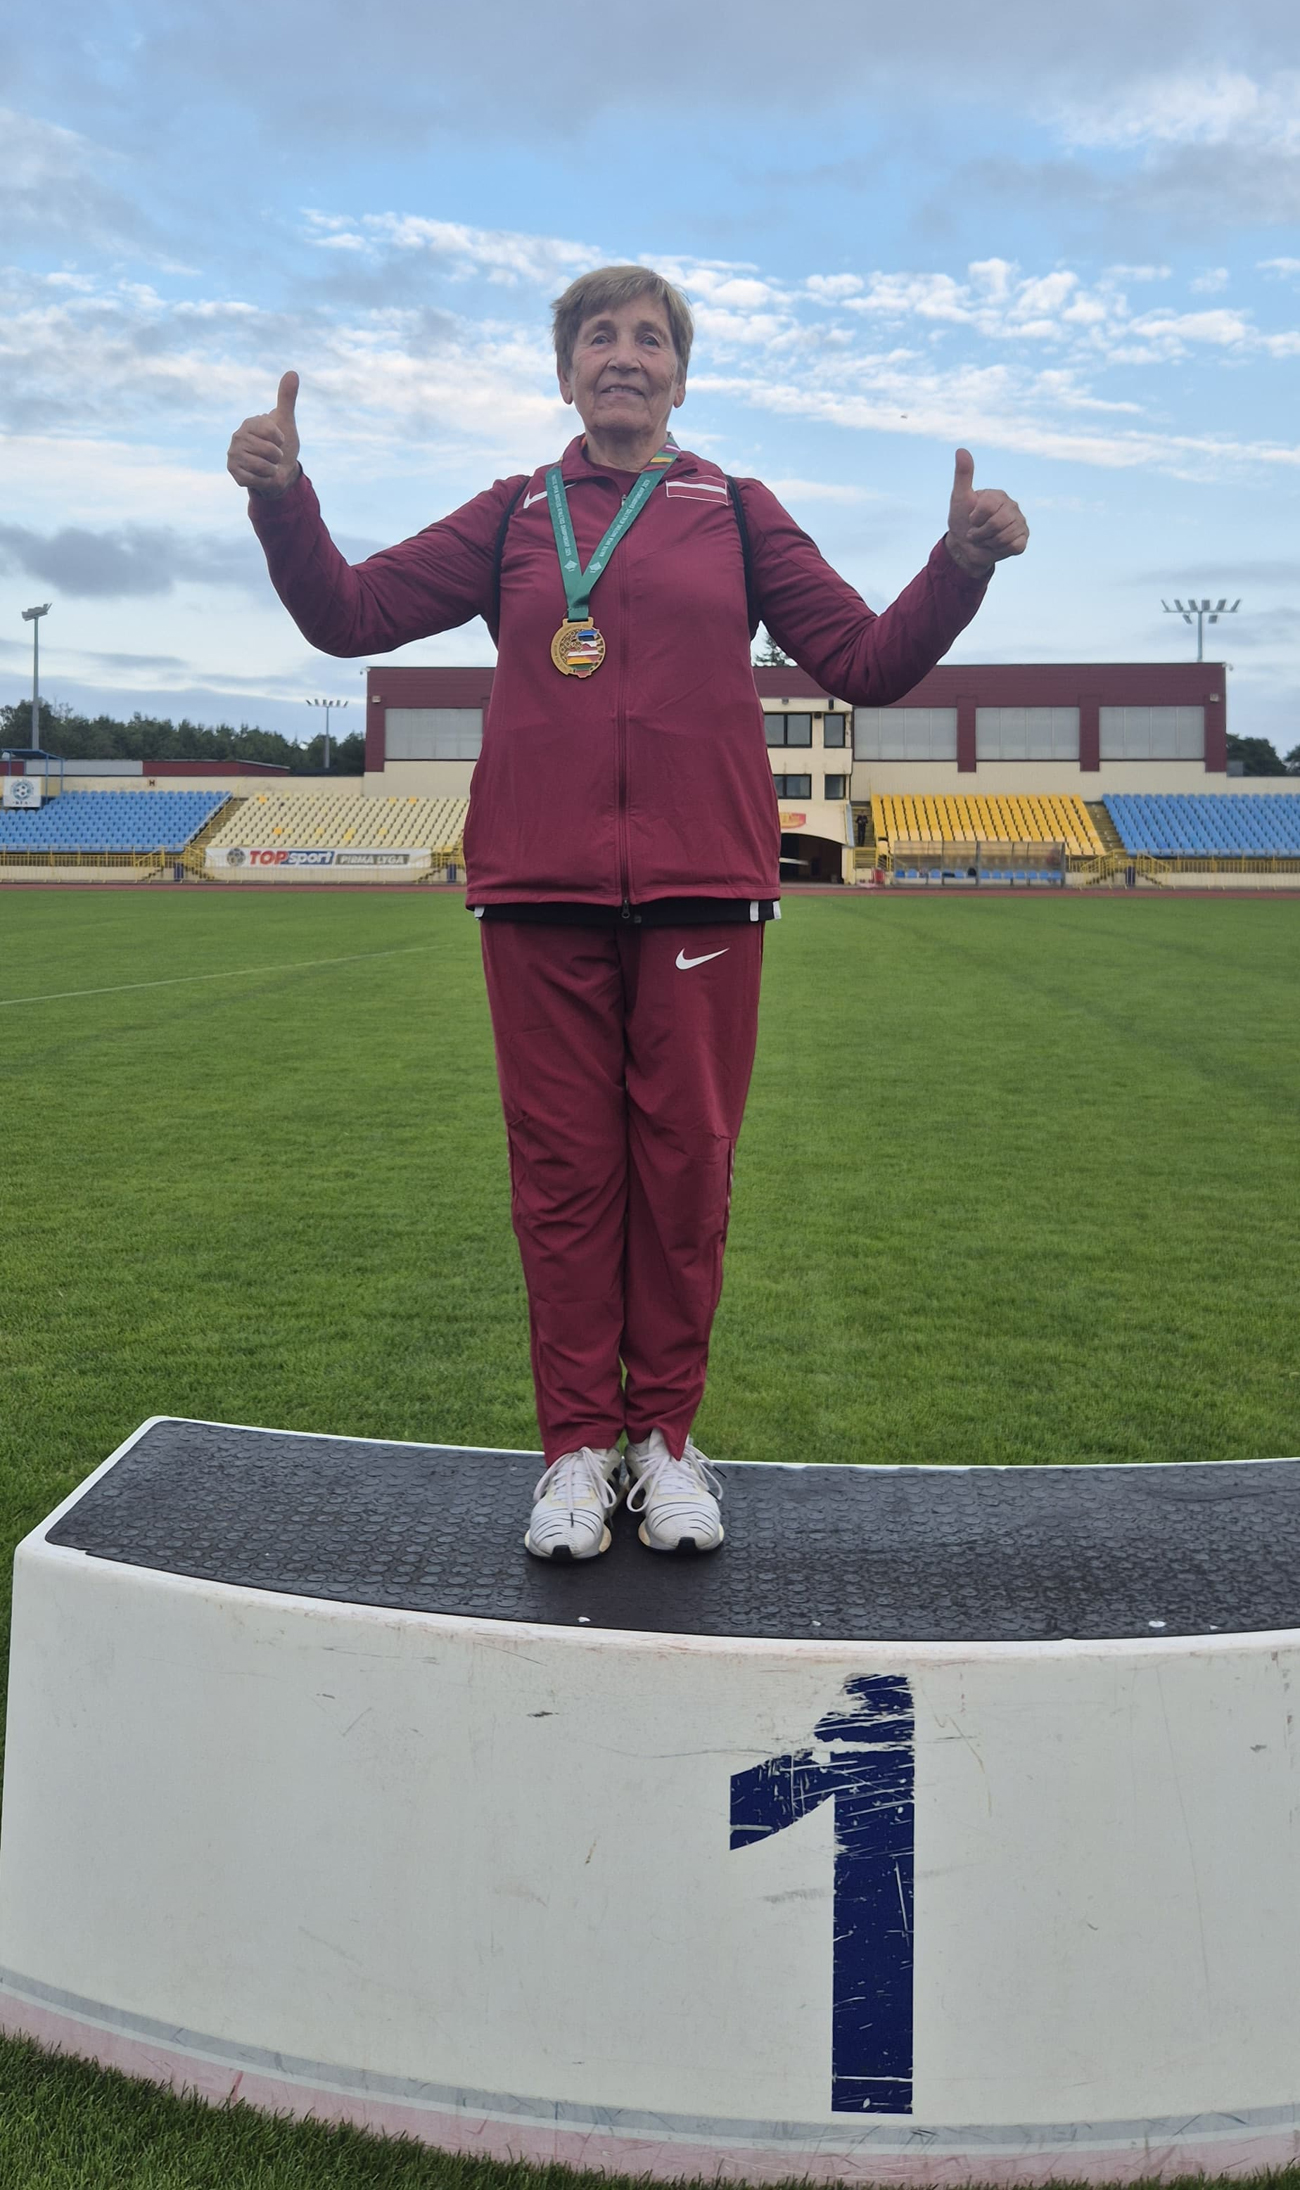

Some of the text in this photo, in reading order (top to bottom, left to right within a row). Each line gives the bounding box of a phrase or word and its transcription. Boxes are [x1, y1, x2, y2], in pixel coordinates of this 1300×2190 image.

[250, 851, 404, 865] TOPsport PIRMA LYGA
[730, 1672, 915, 2114] 1
